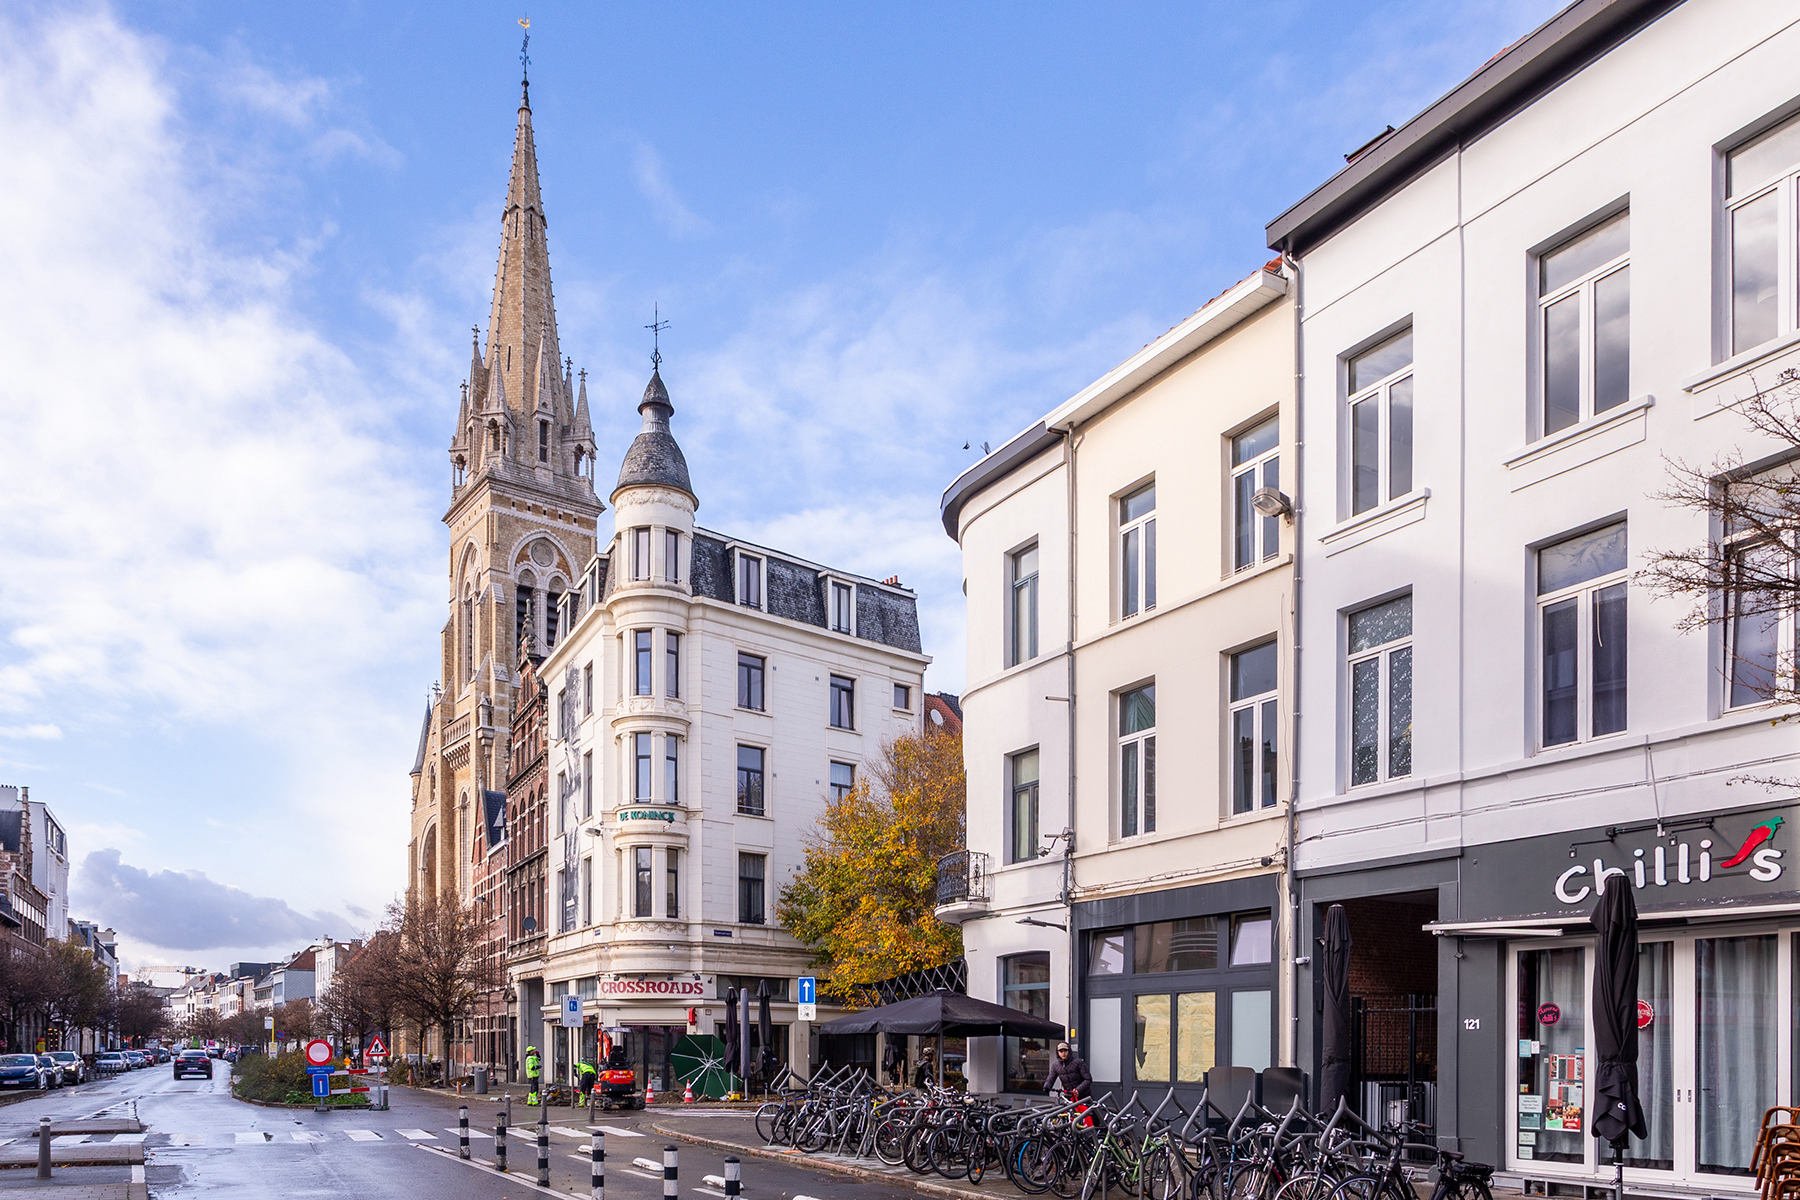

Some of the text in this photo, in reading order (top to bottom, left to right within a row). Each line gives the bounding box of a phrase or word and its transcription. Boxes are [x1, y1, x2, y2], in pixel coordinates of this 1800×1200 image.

[620, 811, 675, 821] DE KONINCK
[601, 981, 704, 995] CROSSROADS
[1463, 1018, 1480, 1030] 121
